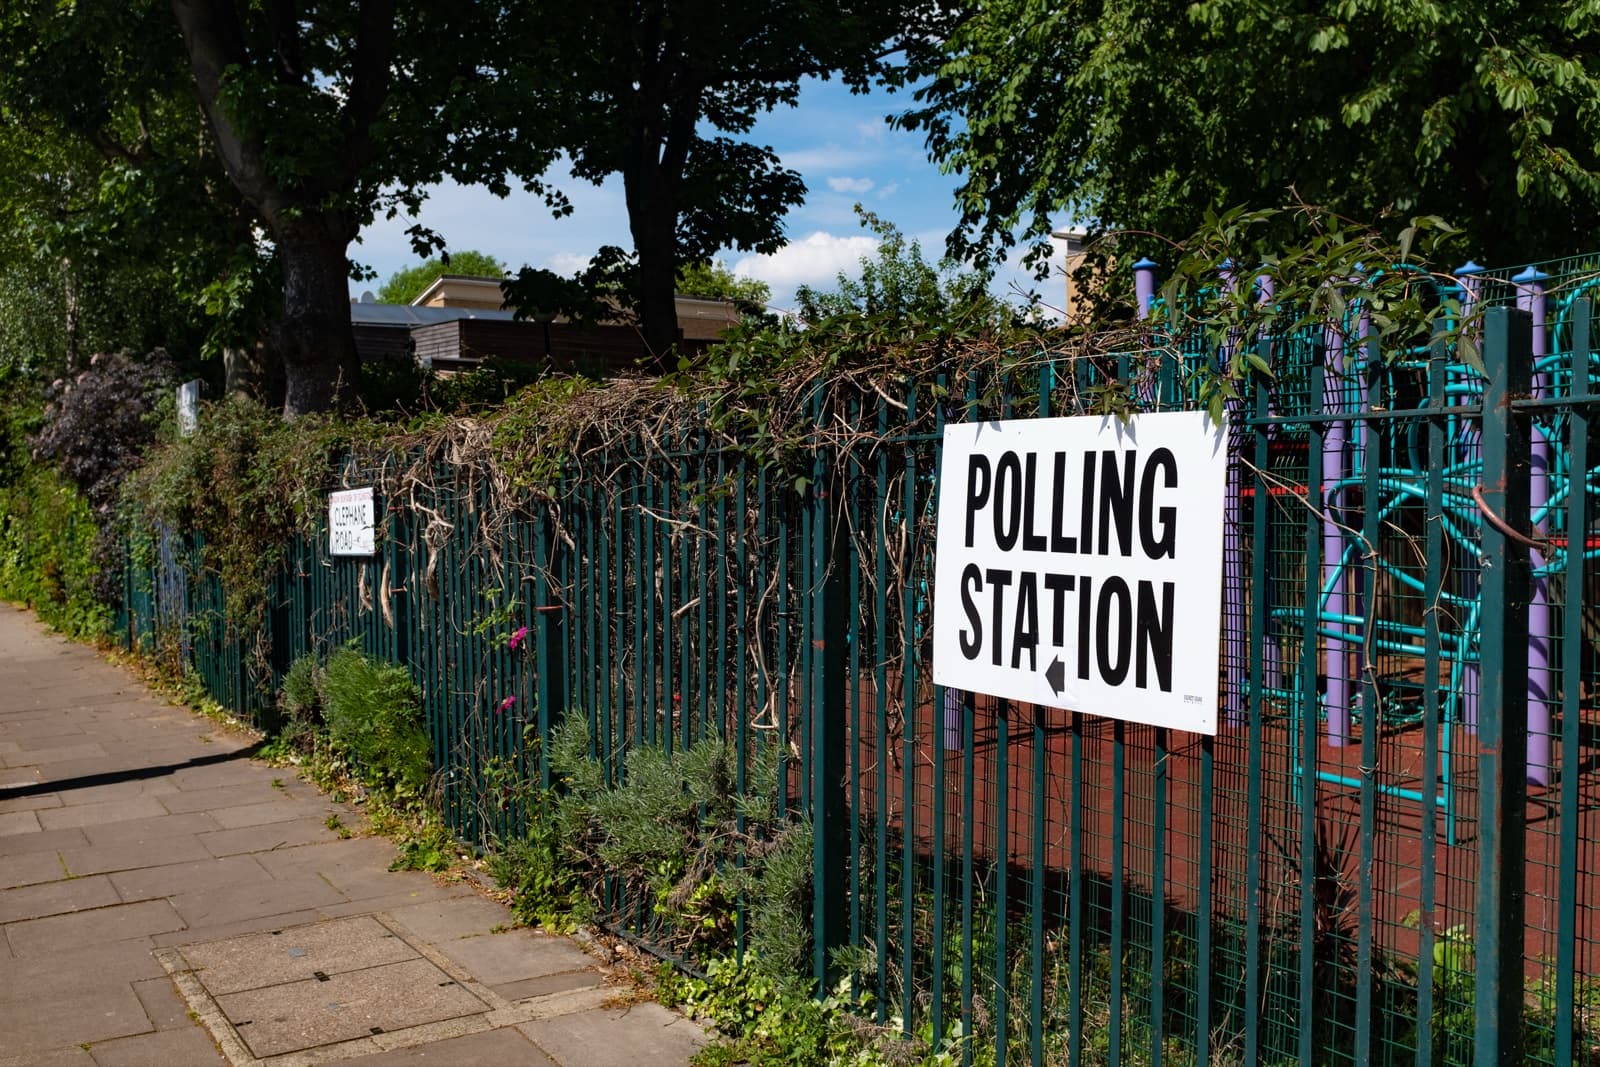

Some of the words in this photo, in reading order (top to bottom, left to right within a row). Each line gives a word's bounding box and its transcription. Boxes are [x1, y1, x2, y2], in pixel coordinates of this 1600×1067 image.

[335, 504, 366, 526] CLEPHANE
[965, 447, 1178, 560] POLLING
[335, 530, 353, 552] ROAD
[959, 562, 1175, 692] STATION
